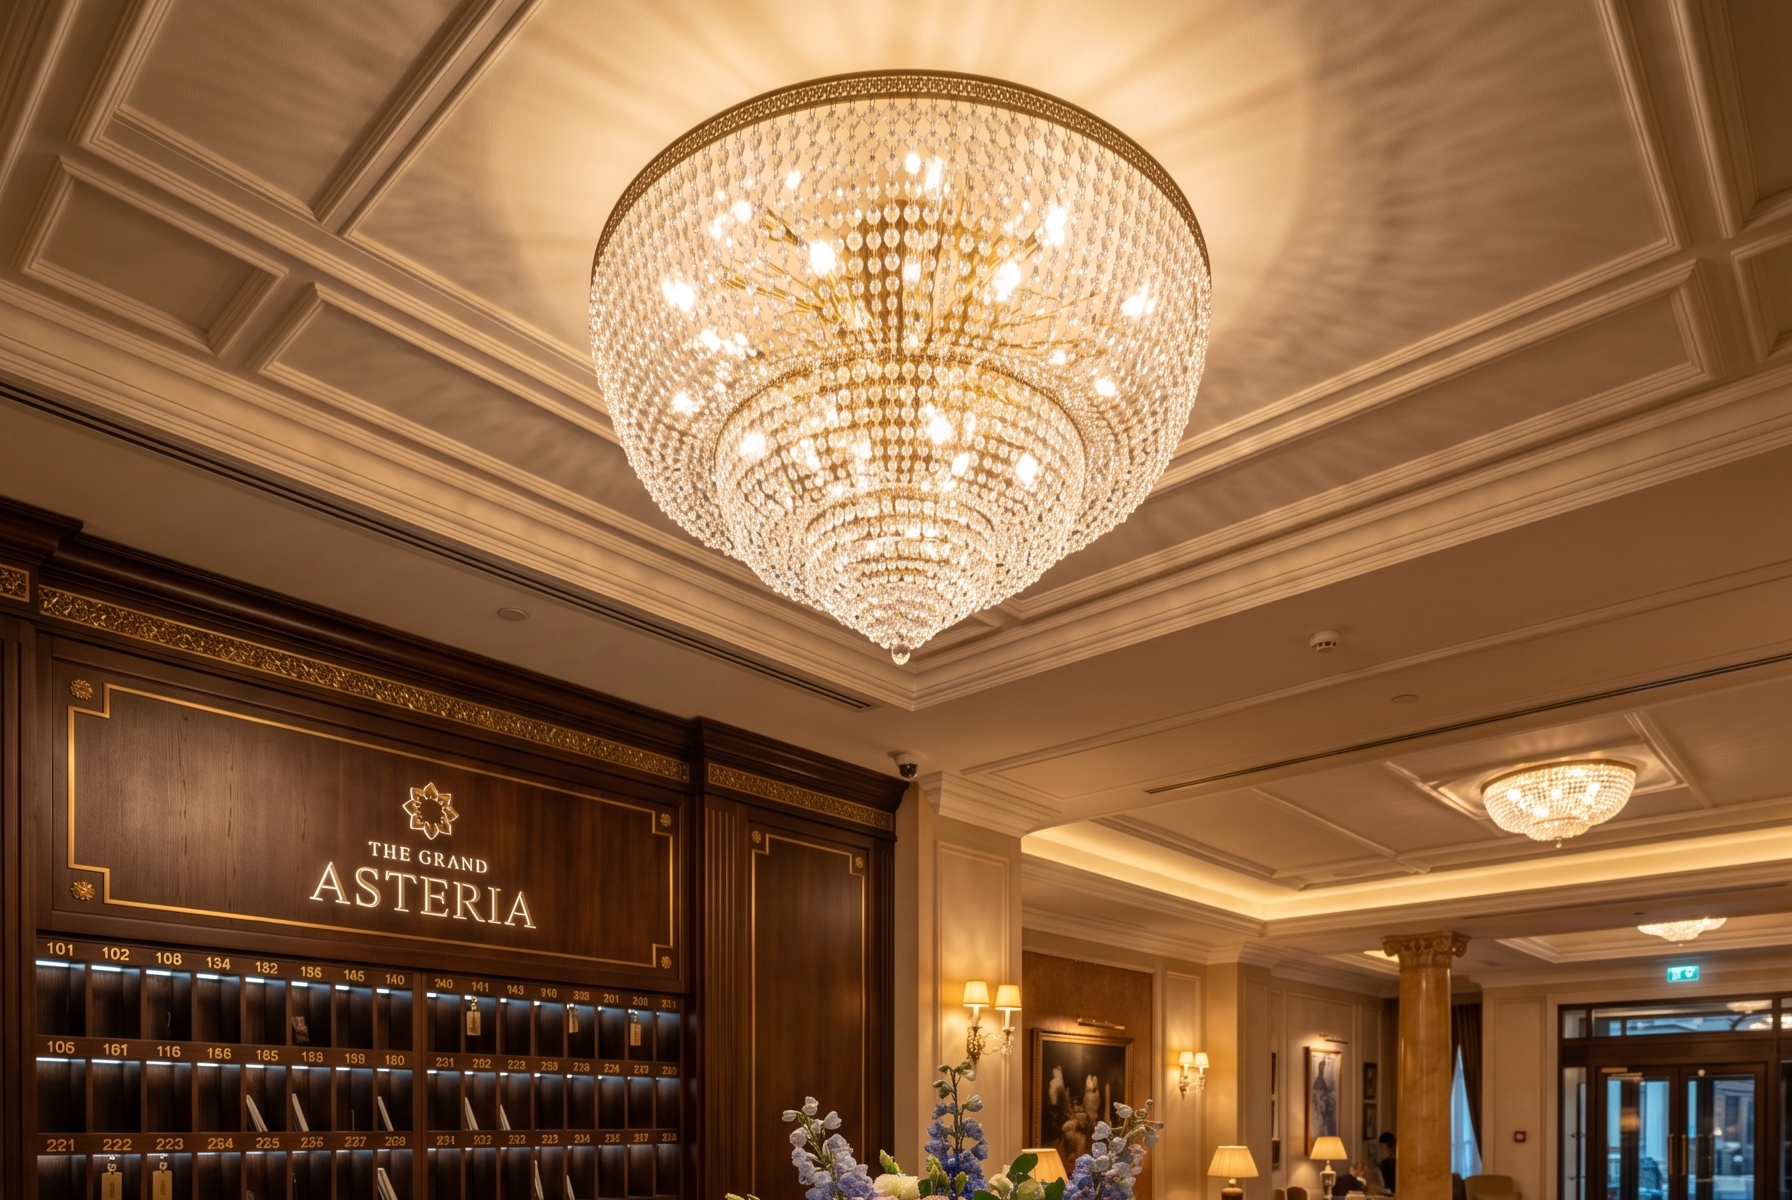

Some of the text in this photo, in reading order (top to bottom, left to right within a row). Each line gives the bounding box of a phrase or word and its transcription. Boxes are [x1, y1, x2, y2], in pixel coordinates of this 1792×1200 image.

[368, 841, 488, 874] THE GRAND
[309, 861, 536, 929] ASTERIA
[47, 942, 74, 956] 101
[102, 947, 130, 961] 102
[155, 952, 182, 966] 108
[46, 1139, 75, 1152] 221
[102, 1138, 132, 1151] 222
[155, 1138, 184, 1150] 223
